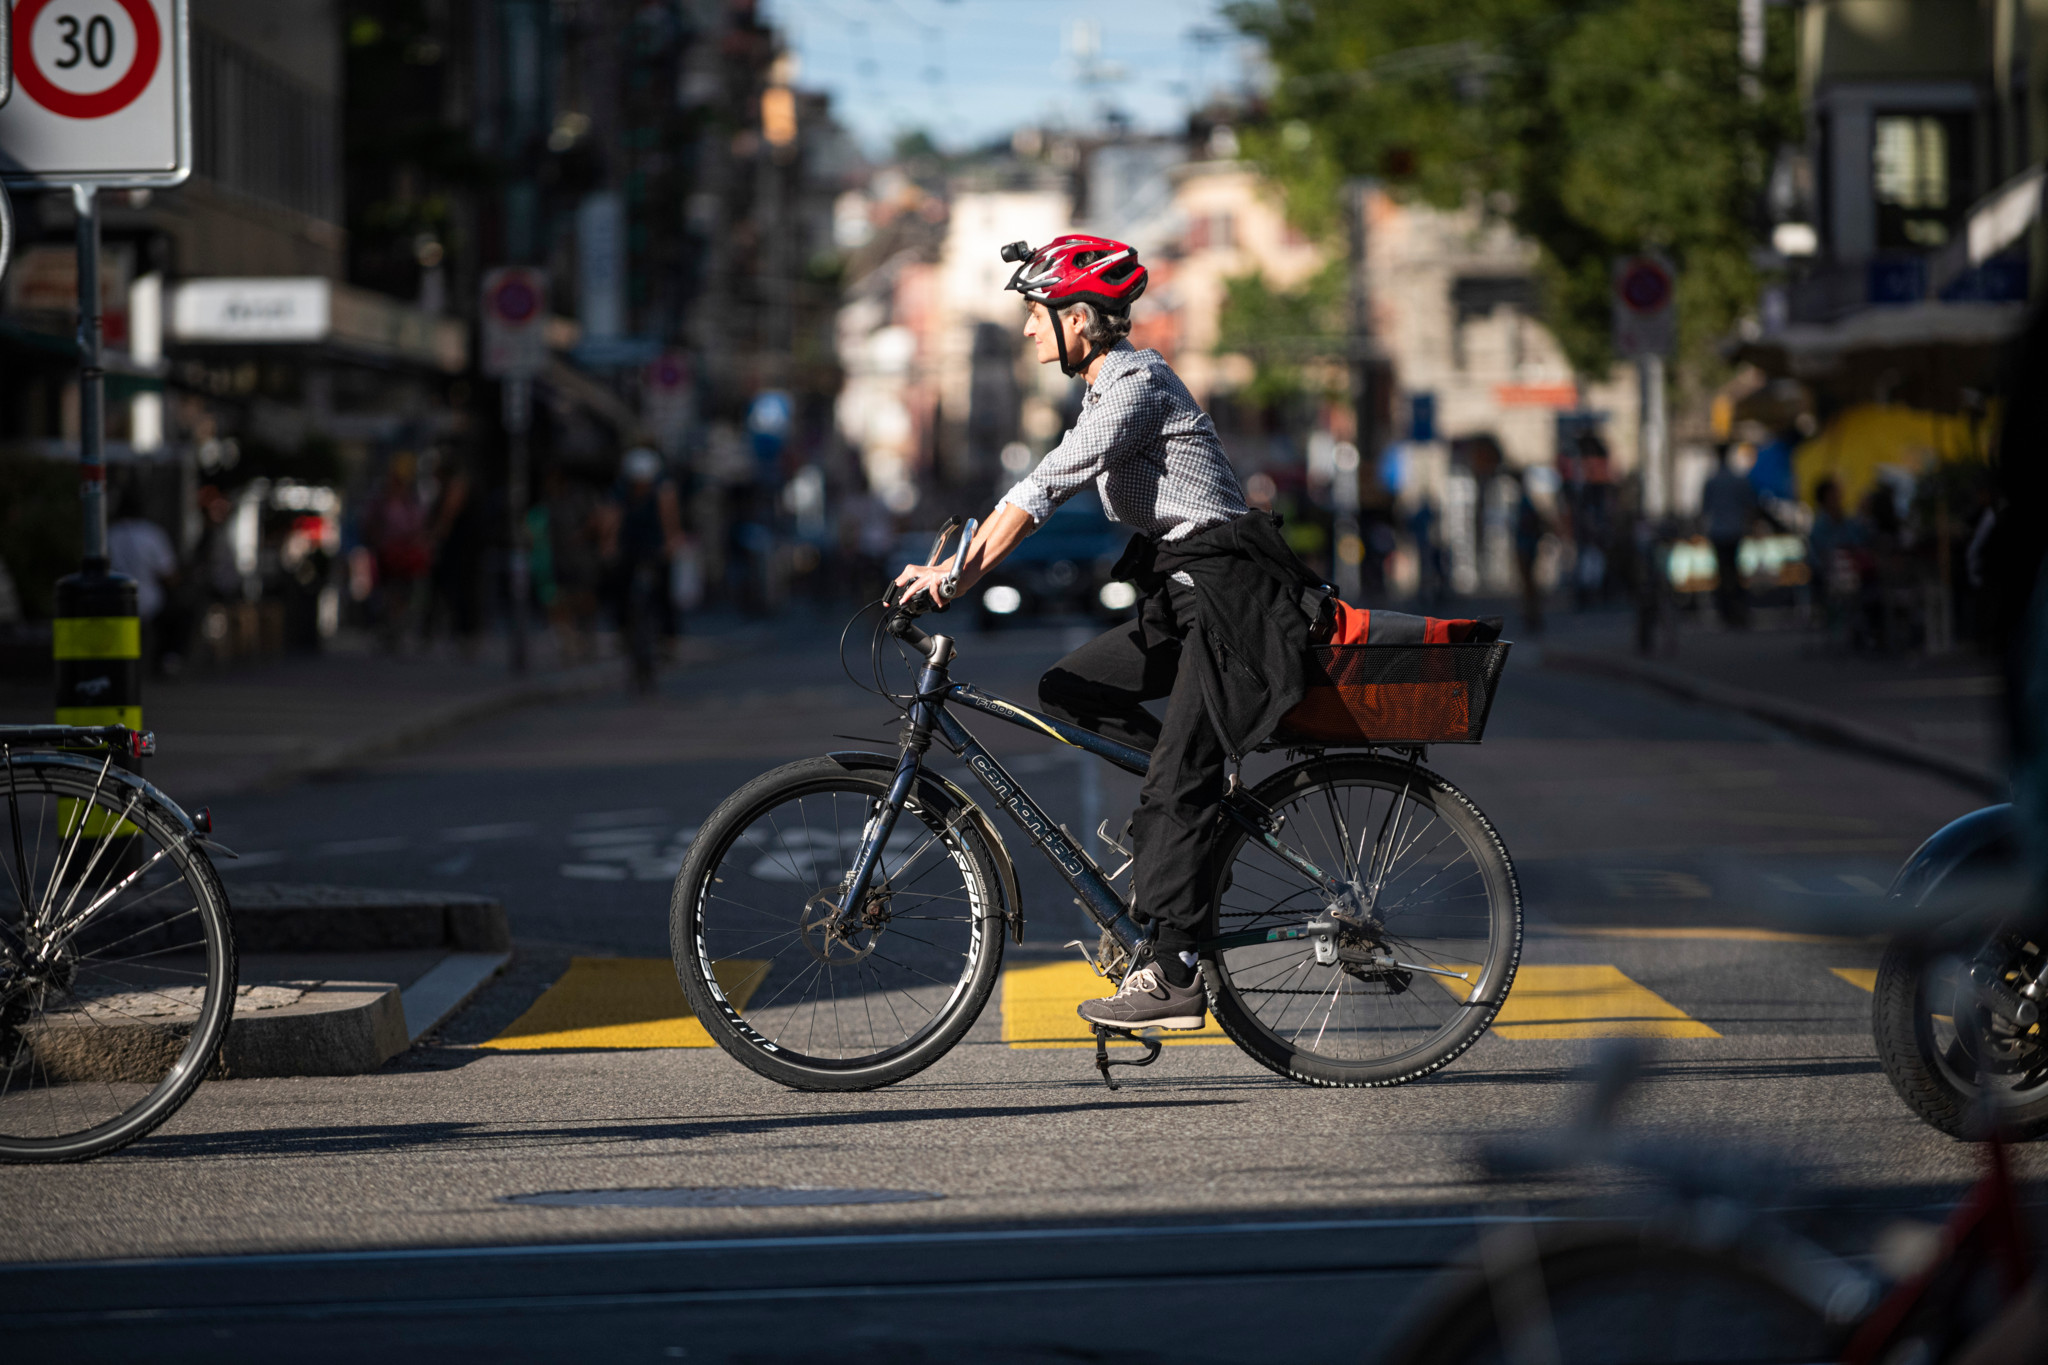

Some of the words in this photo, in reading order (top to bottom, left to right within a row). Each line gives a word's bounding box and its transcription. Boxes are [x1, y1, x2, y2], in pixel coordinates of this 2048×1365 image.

[56, 15, 114, 68] 30
[976, 698, 1016, 718] F1000
[971, 754, 1084, 876] cannondale
[968, 850, 988, 893] MARATHON
